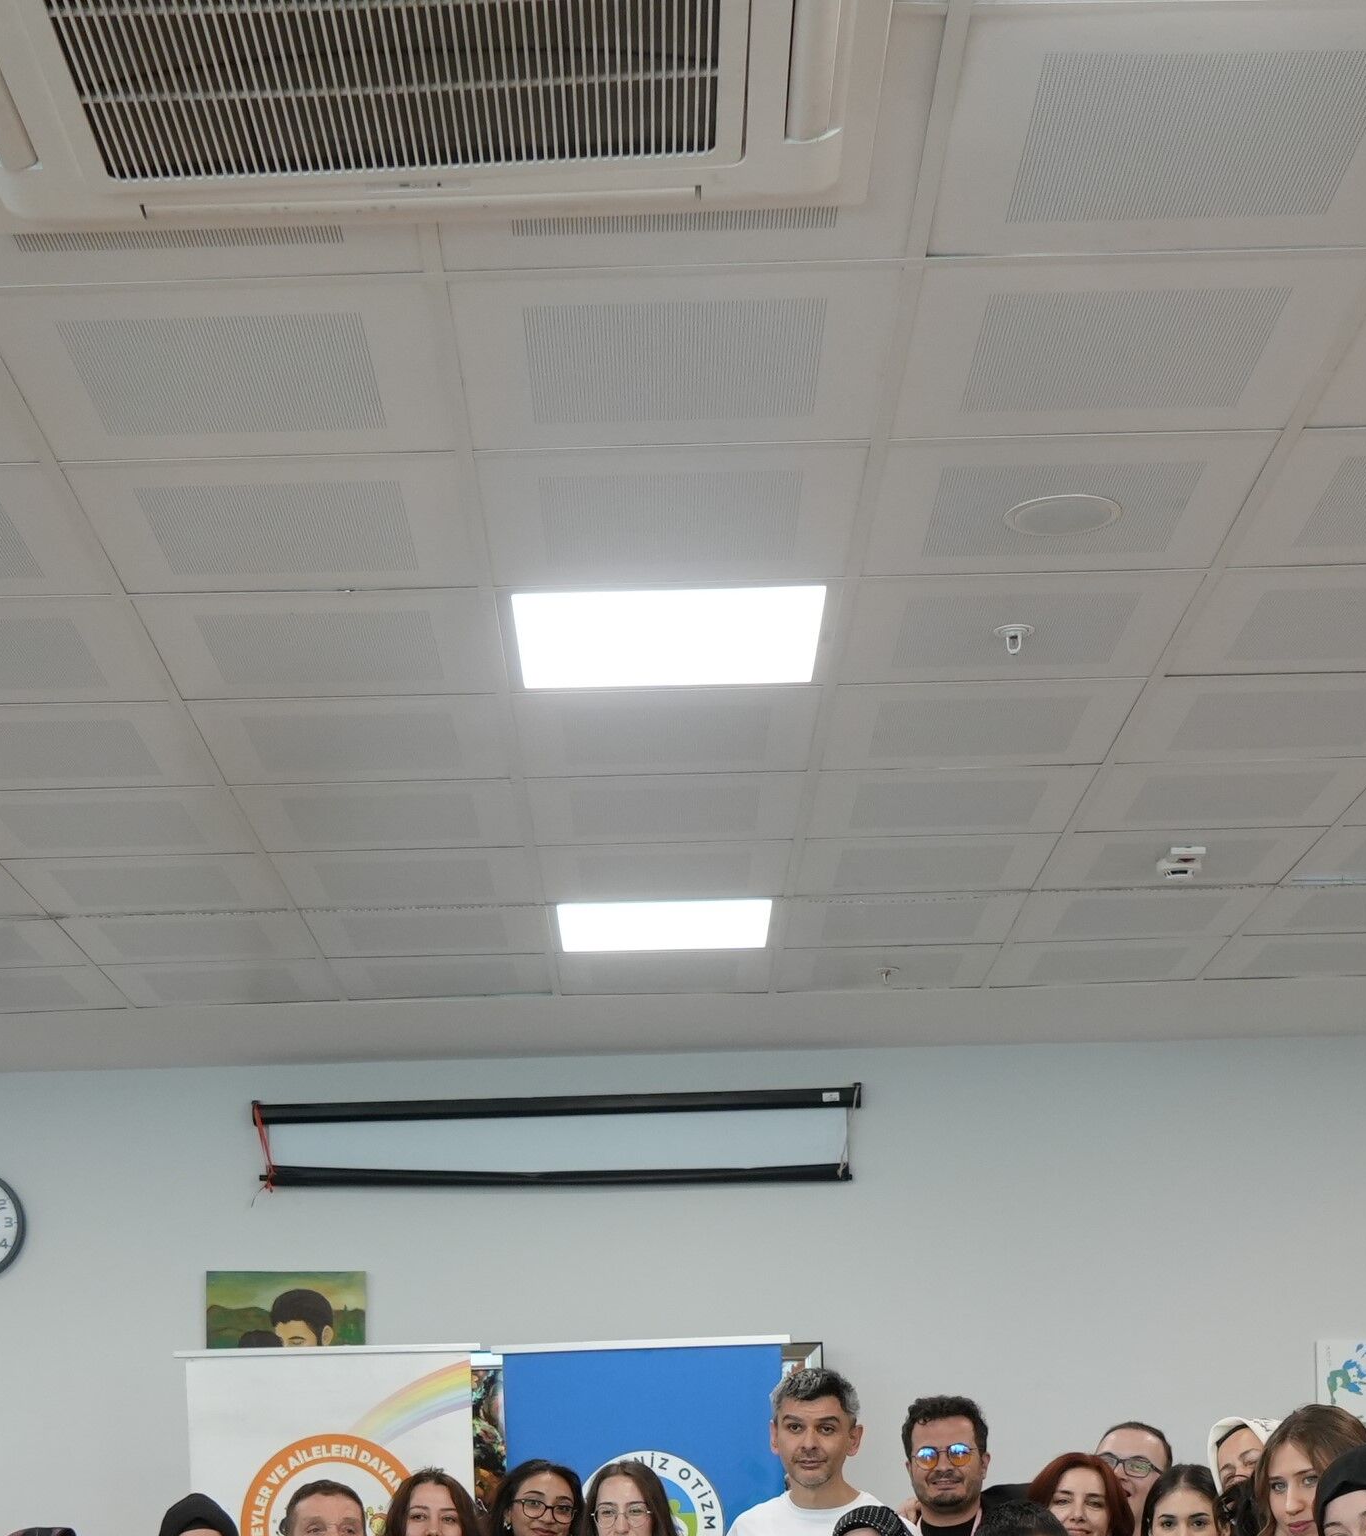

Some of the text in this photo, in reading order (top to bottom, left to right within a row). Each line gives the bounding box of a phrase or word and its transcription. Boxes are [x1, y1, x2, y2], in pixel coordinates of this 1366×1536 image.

[4, 1217, 13, 1228] 3
[266, 1464, 290, 1485] VE
[288, 1443, 359, 1471] AİLELERİ
[678, 1467, 716, 1530] OTİZM
